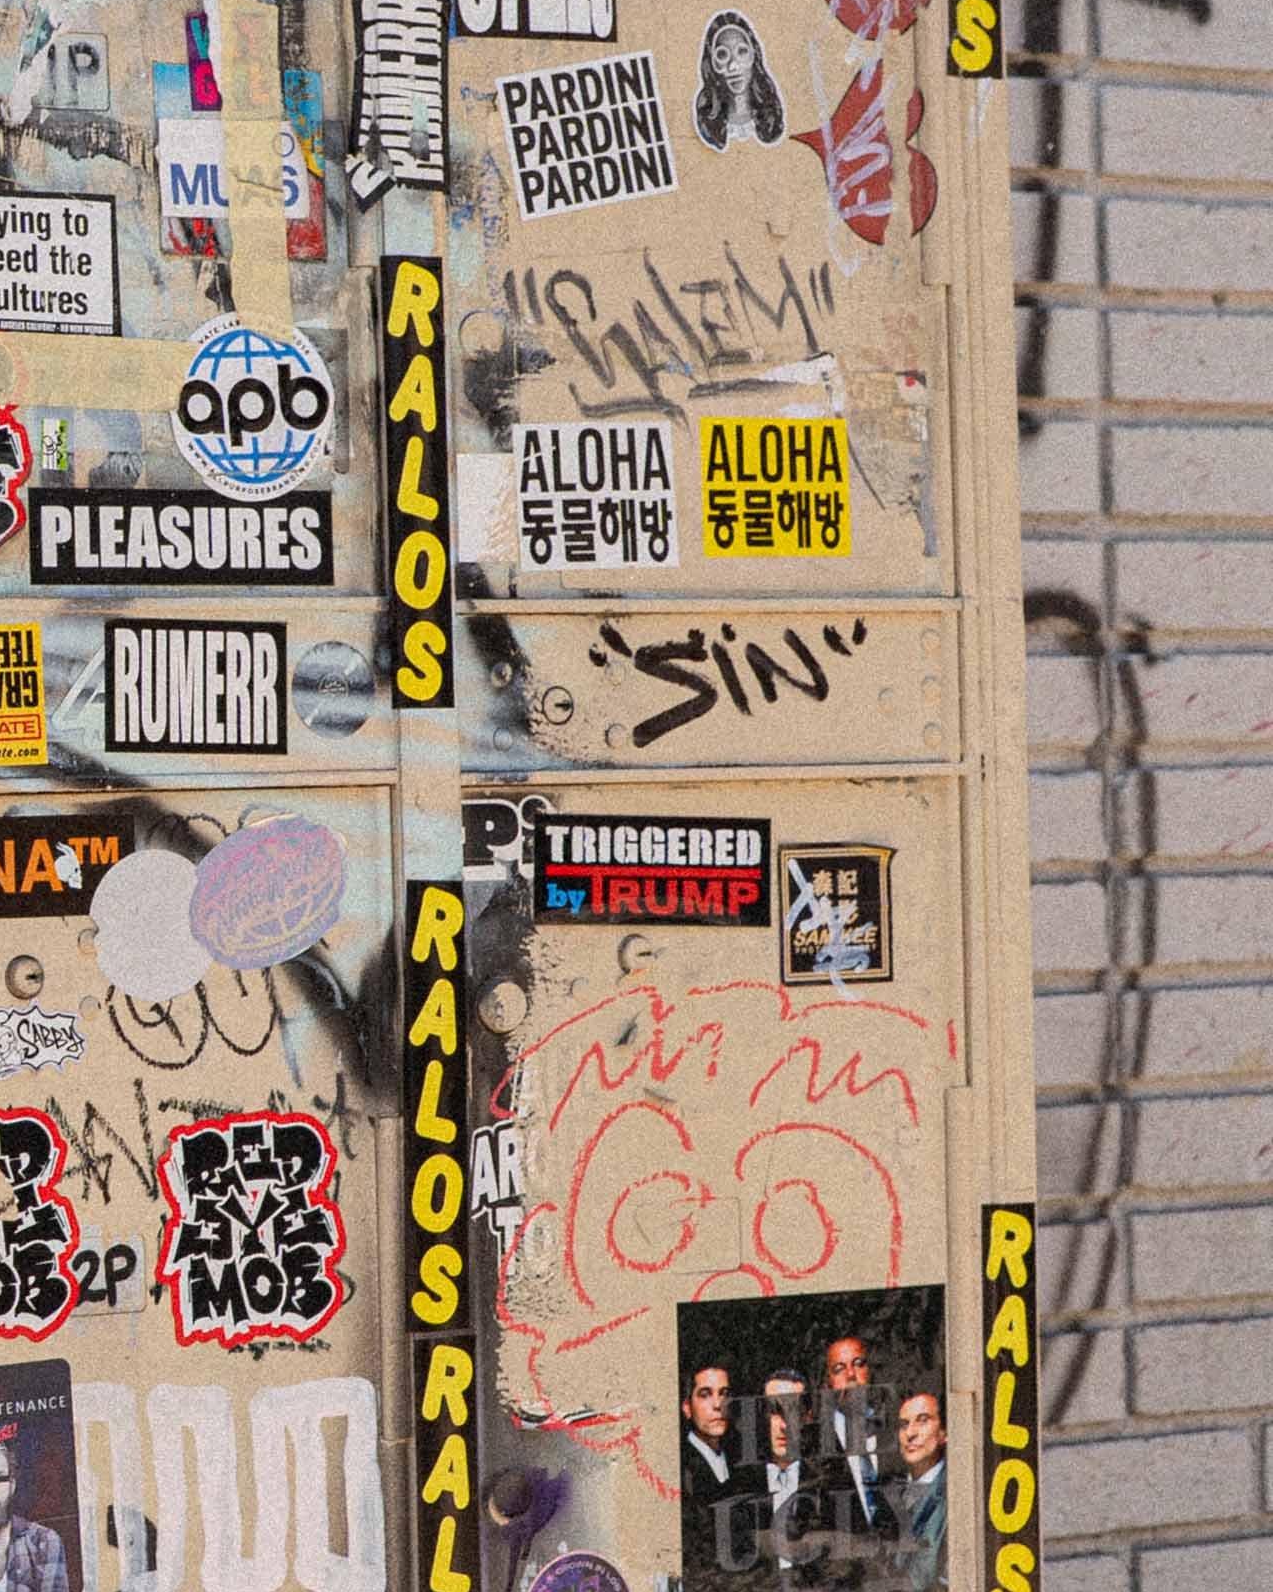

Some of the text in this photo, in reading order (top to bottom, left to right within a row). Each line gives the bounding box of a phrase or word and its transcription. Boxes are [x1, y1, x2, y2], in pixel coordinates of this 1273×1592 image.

[503, 57, 657, 124] PARDINI
[511, 101, 664, 169] PARDINI
[518, 145, 673, 214] PARDINI
[63, 209, 89, 236] to
[50, 247, 91, 276] the
[178, 364, 329, 447] apb
[386, 260, 447, 704] RALOS
[520, 428, 671, 493] ALOHA
[705, 425, 843, 483] ALOHA
[41, 505, 322, 572] PLEASURES
[522, 497, 673, 564] 동물해방
[707, 489, 844, 550] 동물해방
[114, 627, 277, 748] RUMERR
[546, 825, 761, 866] TRIGGERED
[547, 872, 760, 916] by TRUMP
[17, 1019, 85, 1059] SABBY
[409, 887, 465, 1325] RALOS
[181, 1124, 324, 1198] RED
[72, 1245, 136, 1305] 2P
[189, 1244, 334, 1329] MOB
